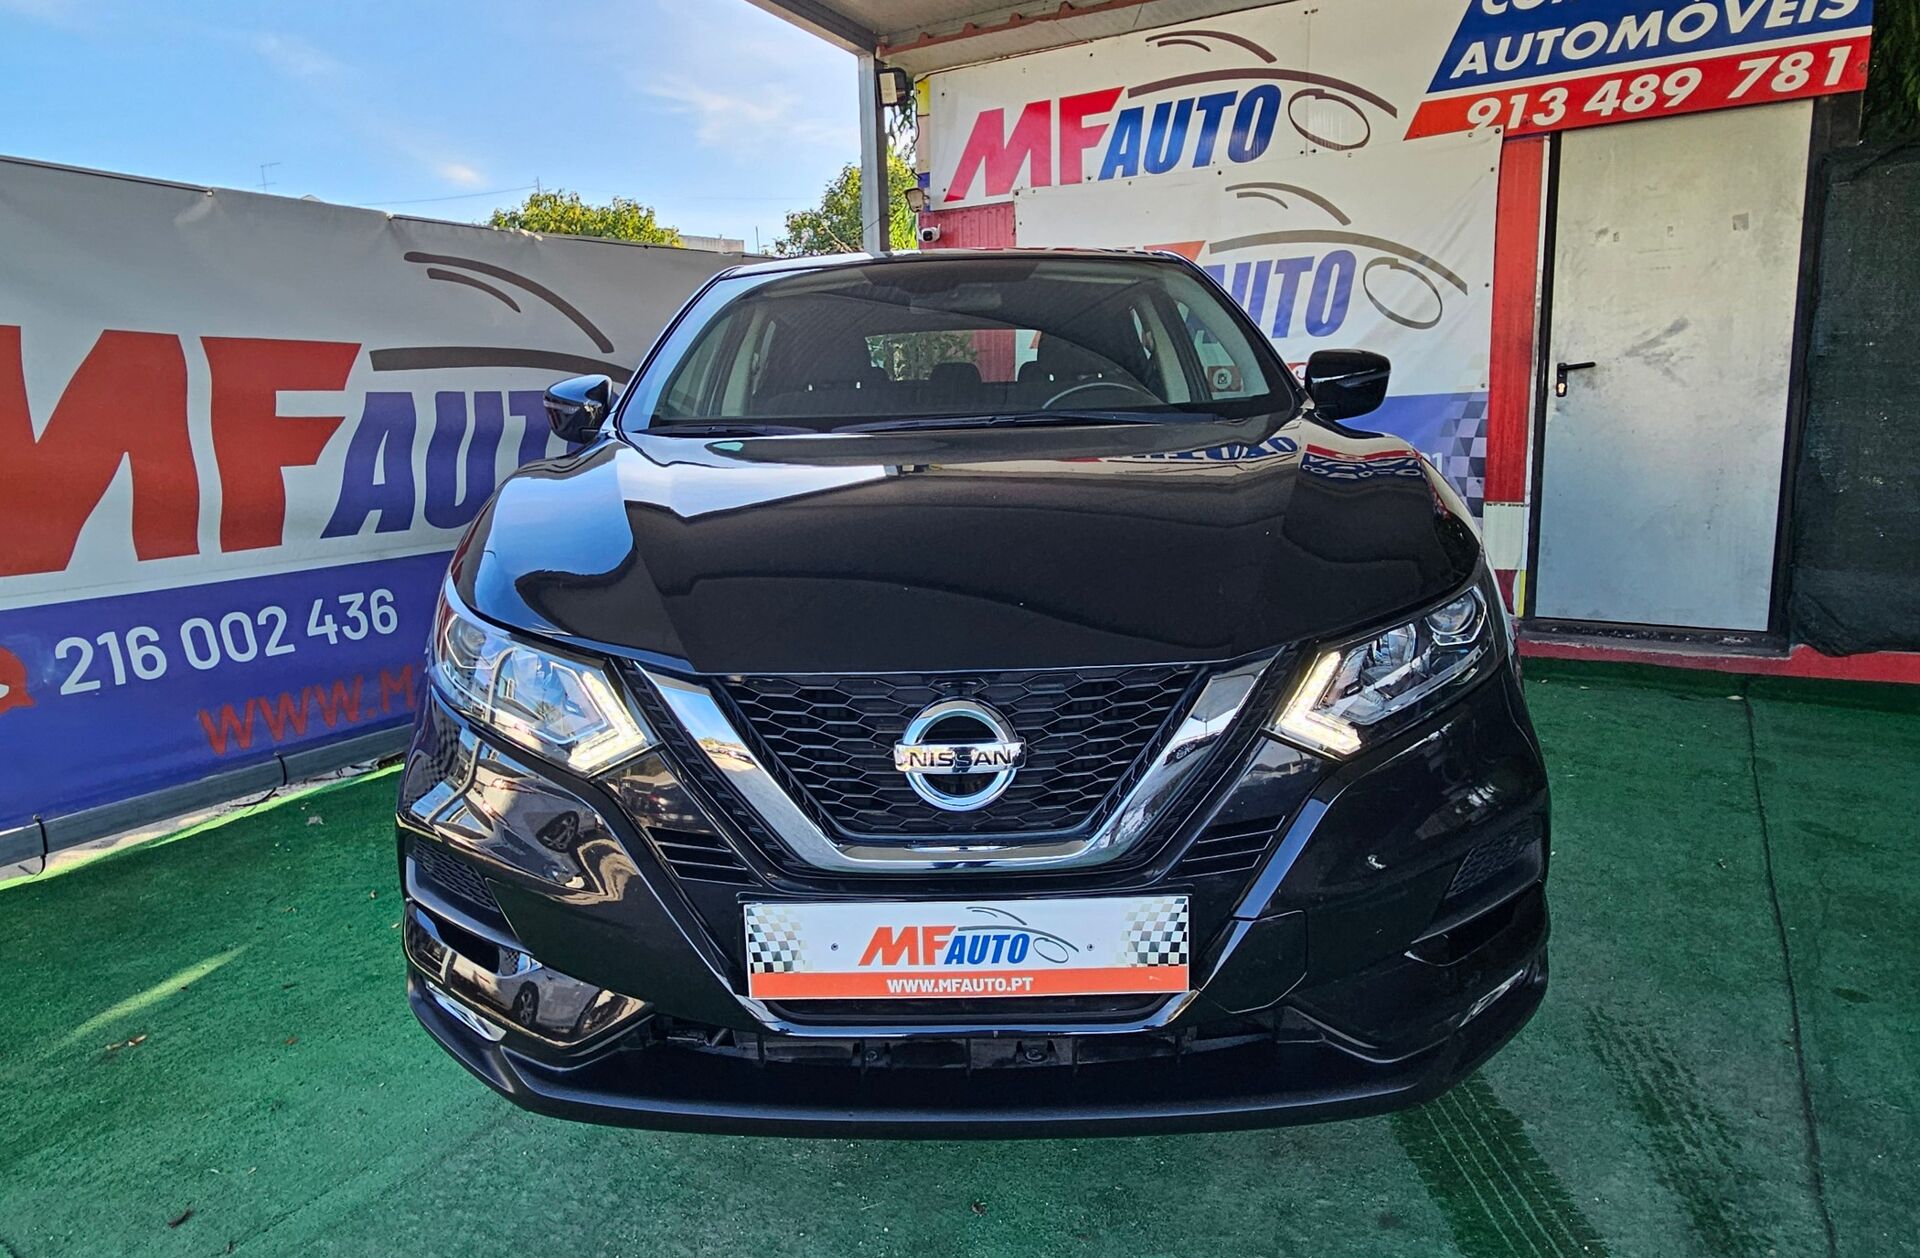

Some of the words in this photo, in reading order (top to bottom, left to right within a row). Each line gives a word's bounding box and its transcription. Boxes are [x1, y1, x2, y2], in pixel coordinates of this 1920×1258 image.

[1450, 0, 1861, 79] AUTOMÓVEIS
[1467, 87, 1569, 130] 913
[1583, 67, 1702, 117] 489
[1727, 45, 1853, 100] 781
[54, 626, 167, 695] 216
[181, 605, 296, 671] 002
[306, 588, 399, 646] 436
[198, 659, 419, 757] WWW.M
[909, 749, 1013, 768] NISSAN
[887, 976, 1034, 993] WWW.MFAUTO.PT
